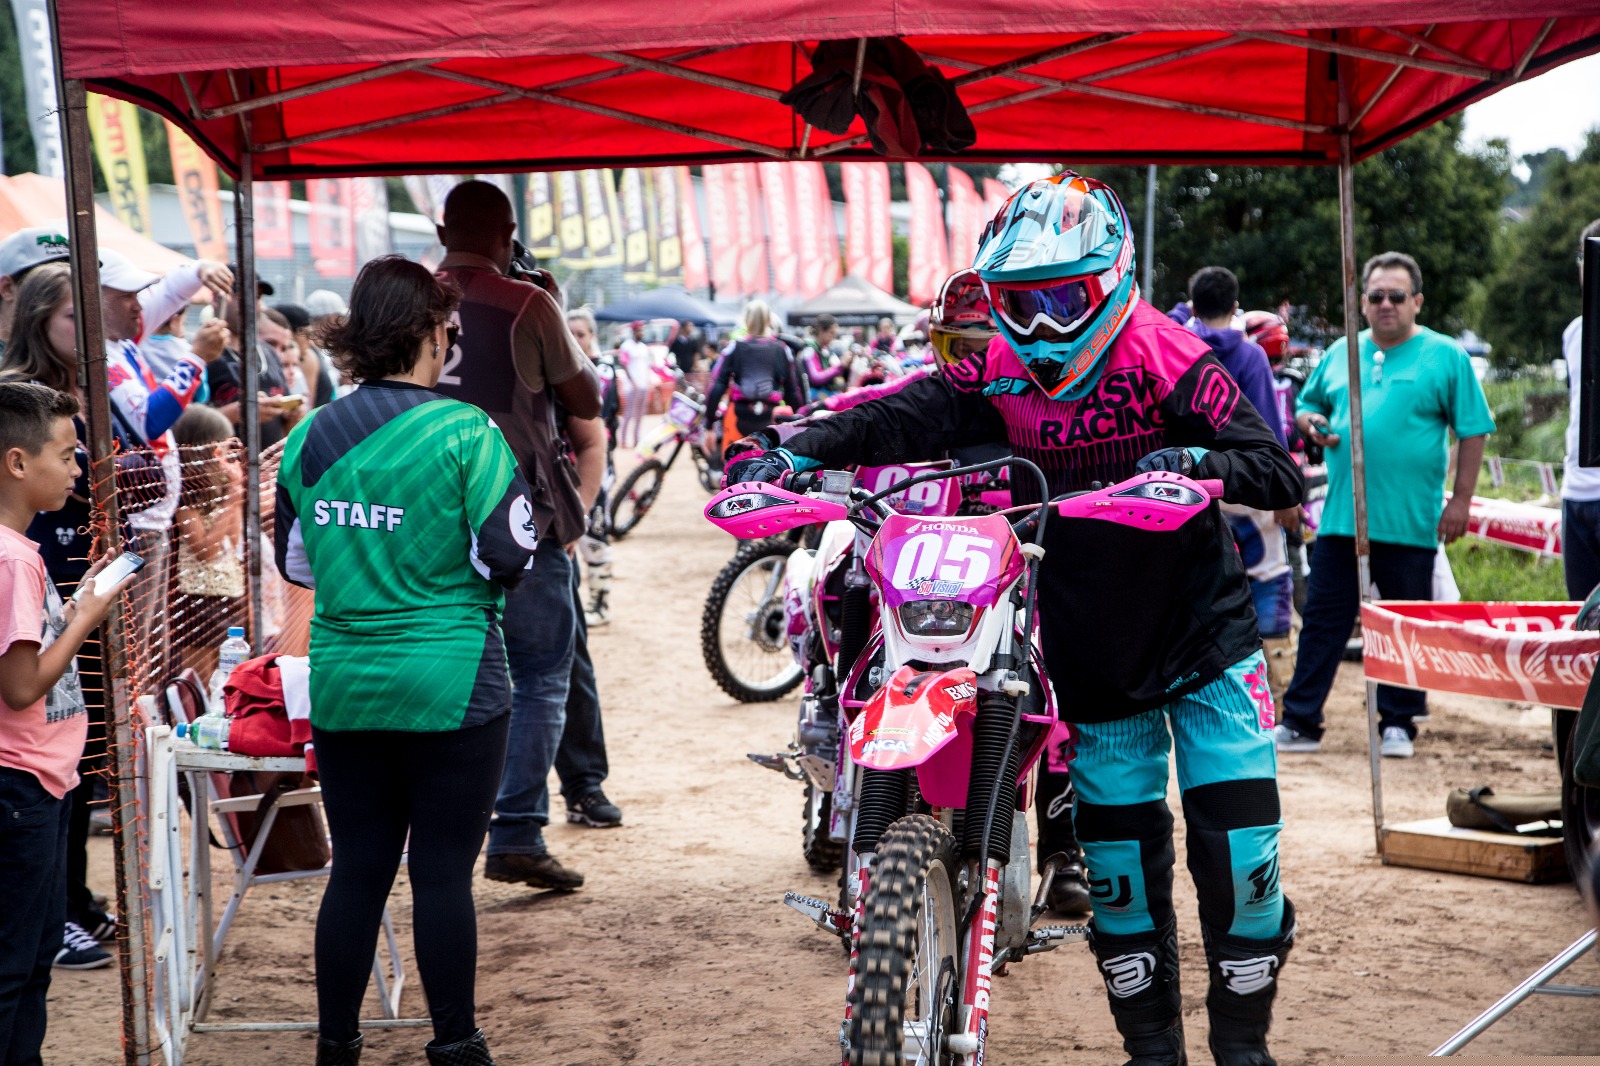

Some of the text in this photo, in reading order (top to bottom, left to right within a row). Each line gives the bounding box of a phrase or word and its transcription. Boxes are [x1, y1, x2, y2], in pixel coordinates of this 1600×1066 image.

[1039, 405, 1166, 448] RACING
[314, 498, 405, 533] STAFF
[921, 522, 980, 535] HONDA
[891, 532, 994, 590] 05
[917, 580, 963, 595] SigVisual
[1424, 645, 1515, 682] HONDA
[922, 711, 954, 748] MOTUL
